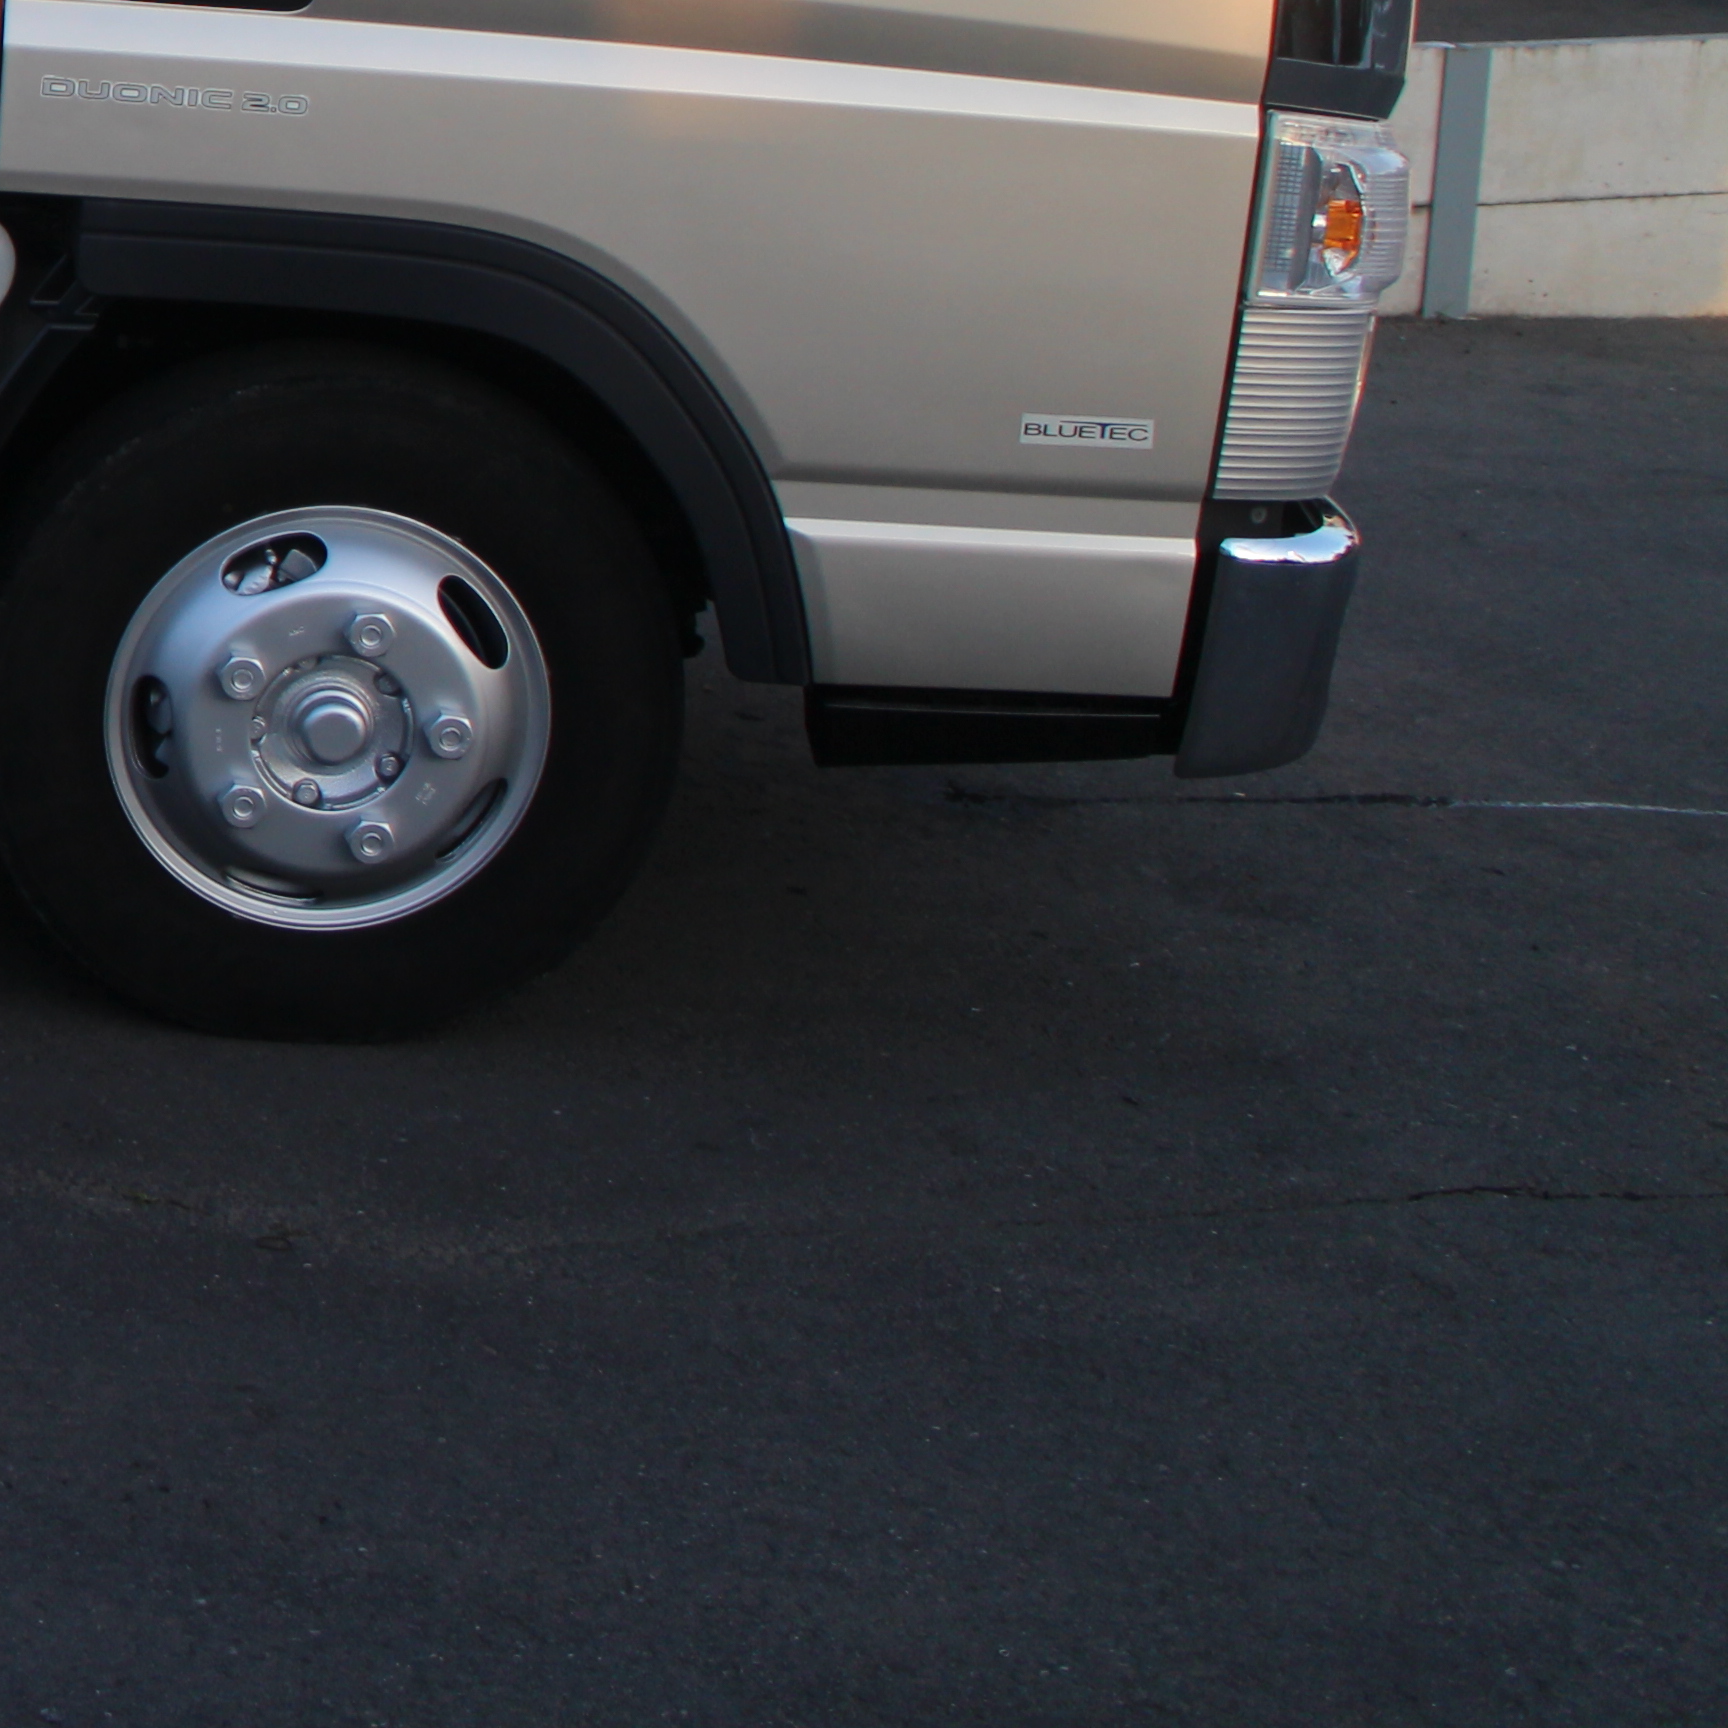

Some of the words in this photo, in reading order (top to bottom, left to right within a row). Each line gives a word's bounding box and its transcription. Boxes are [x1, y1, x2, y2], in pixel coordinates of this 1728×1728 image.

[40, 74, 234, 111] DUONIC
[240, 91, 310, 117] 2.0
[1023, 420, 1149, 442] BLUETEC
